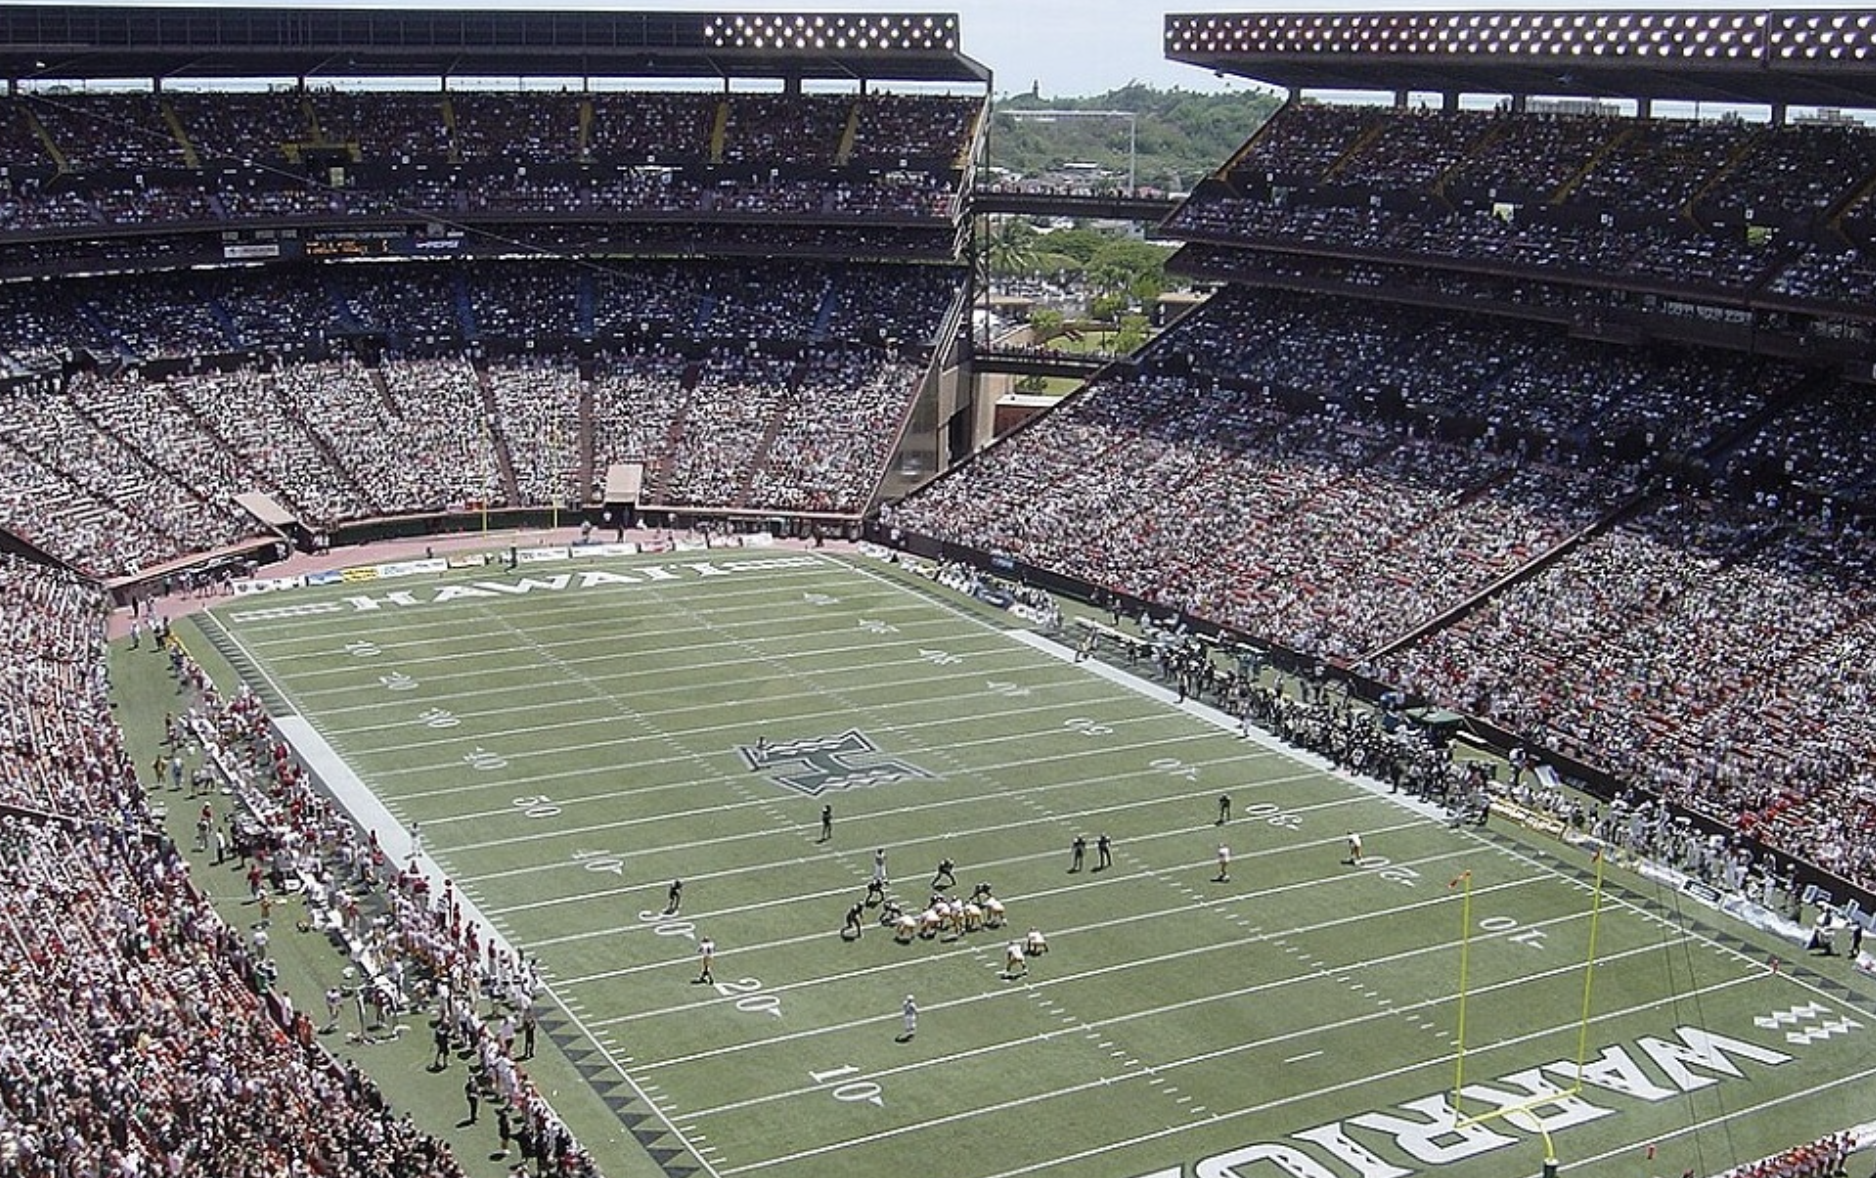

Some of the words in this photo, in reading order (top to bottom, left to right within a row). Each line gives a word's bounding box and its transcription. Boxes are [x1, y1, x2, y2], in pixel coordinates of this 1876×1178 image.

[1478, 916, 1548, 944] 10
[713, 977, 782, 1013] 20
[808, 1063, 884, 1102] 10
